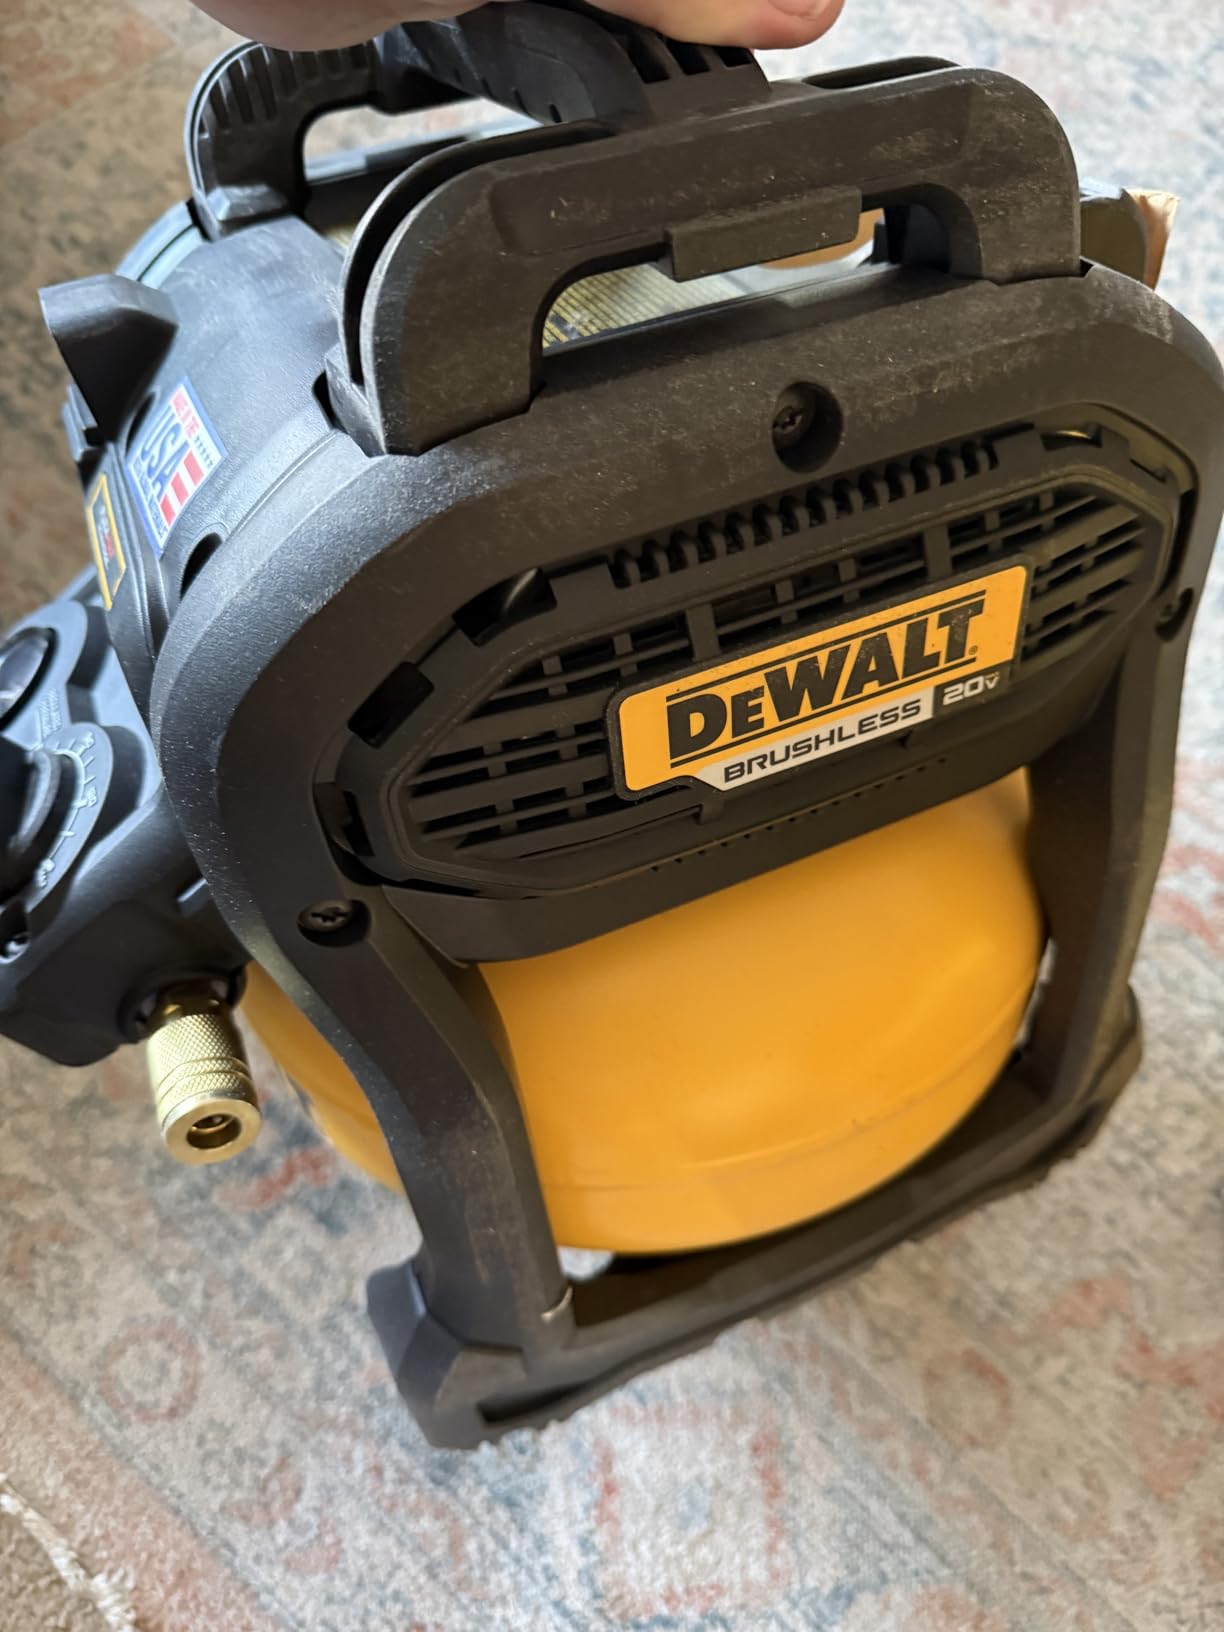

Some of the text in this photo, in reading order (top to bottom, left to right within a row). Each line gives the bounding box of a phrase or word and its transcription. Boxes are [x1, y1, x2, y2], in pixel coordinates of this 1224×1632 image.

[140, 405, 190, 500] USA
[666, 598, 985, 759] DEWALT
[723, 697, 922, 784] BRUSHLESS
